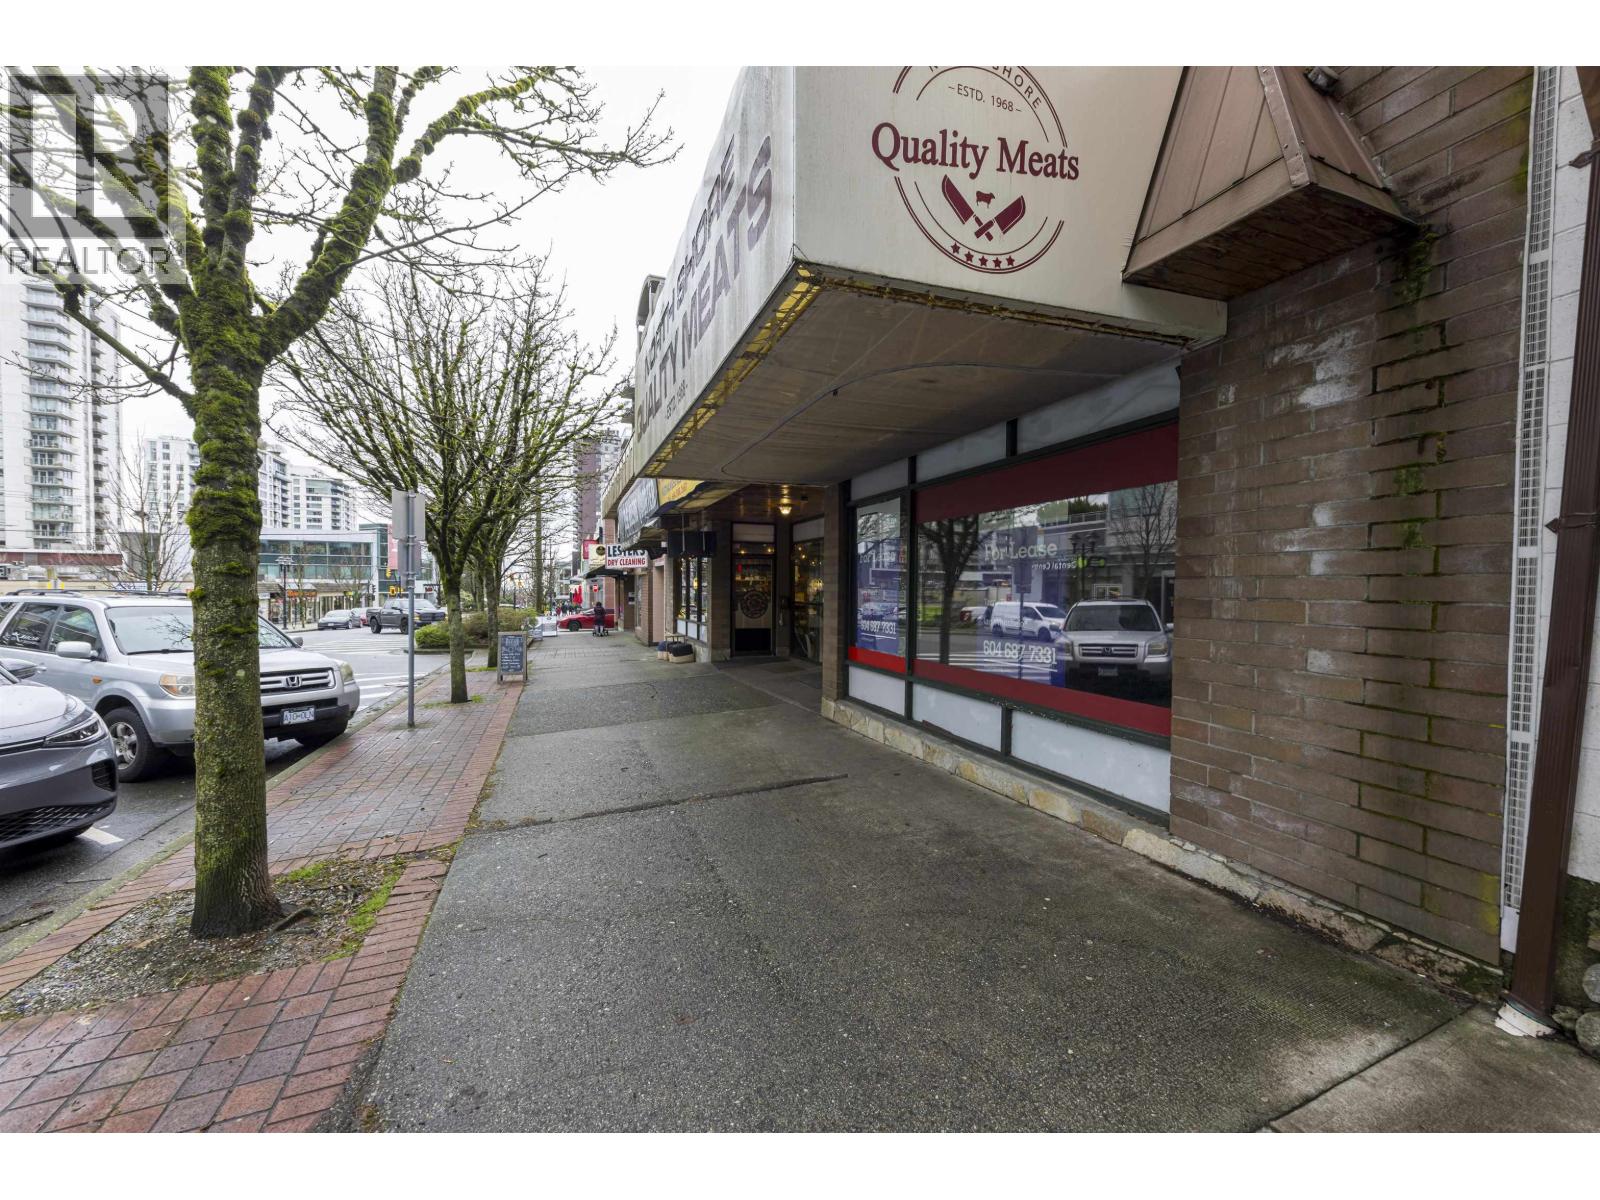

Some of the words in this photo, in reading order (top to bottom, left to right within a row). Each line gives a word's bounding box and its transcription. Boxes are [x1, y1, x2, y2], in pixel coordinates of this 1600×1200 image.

[957, 83, 985, 103] ESTD.
[991, 95, 1014, 112] 1968
[872, 122, 989, 180] Quality
[996, 137, 1080, 180] Meats
[636, 327, 680, 443] QUALITY
[682, 135, 773, 369] MEATS
[619, 558, 646, 566] CLEANING
[984, 543, 1004, 561] For
[1008, 541, 1058, 559] Lease
[983, 640, 1002, 657] 604
[1004, 643, 1025, 661] 687
[1028, 645, 1058, 665] 7331
